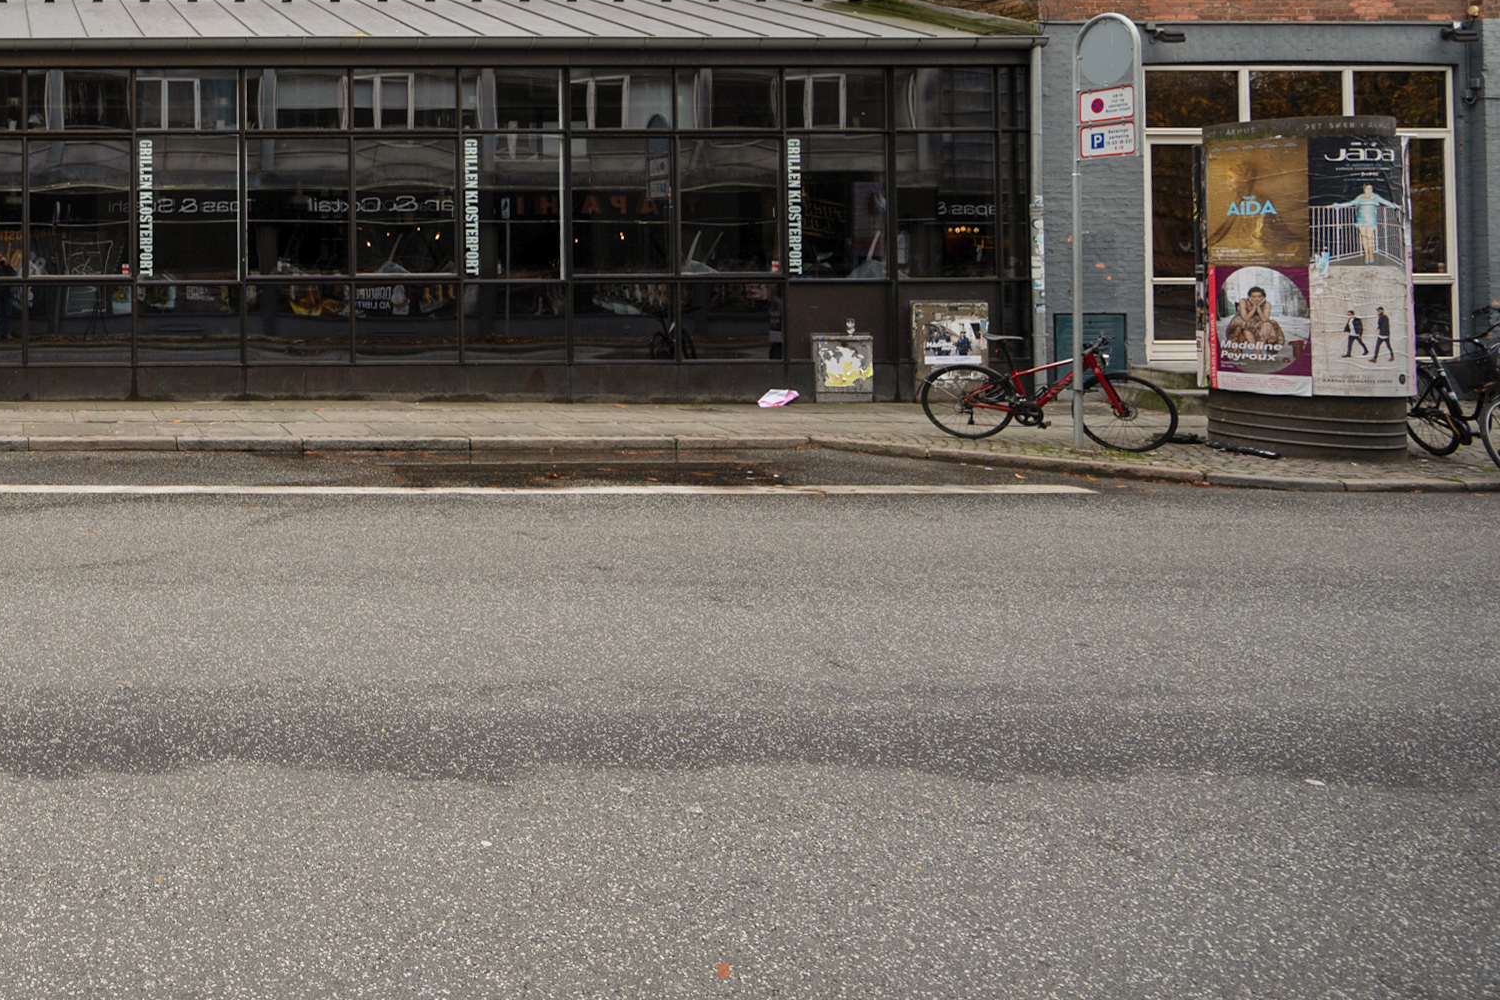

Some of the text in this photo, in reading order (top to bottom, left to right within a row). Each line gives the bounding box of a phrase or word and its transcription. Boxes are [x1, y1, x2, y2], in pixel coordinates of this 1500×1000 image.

[140, 140, 153, 277] GRILLEN KLOSTERPORT
[464, 139, 479, 276] GRILLEN KLOSTERPORT
[787, 138, 802, 275] GRILLEN KLOSTERPORT
[1226, 200, 1277, 216] AIDA
[1220, 340, 1283, 351] Madeline
[1220, 351, 1277, 361] Peyroux
